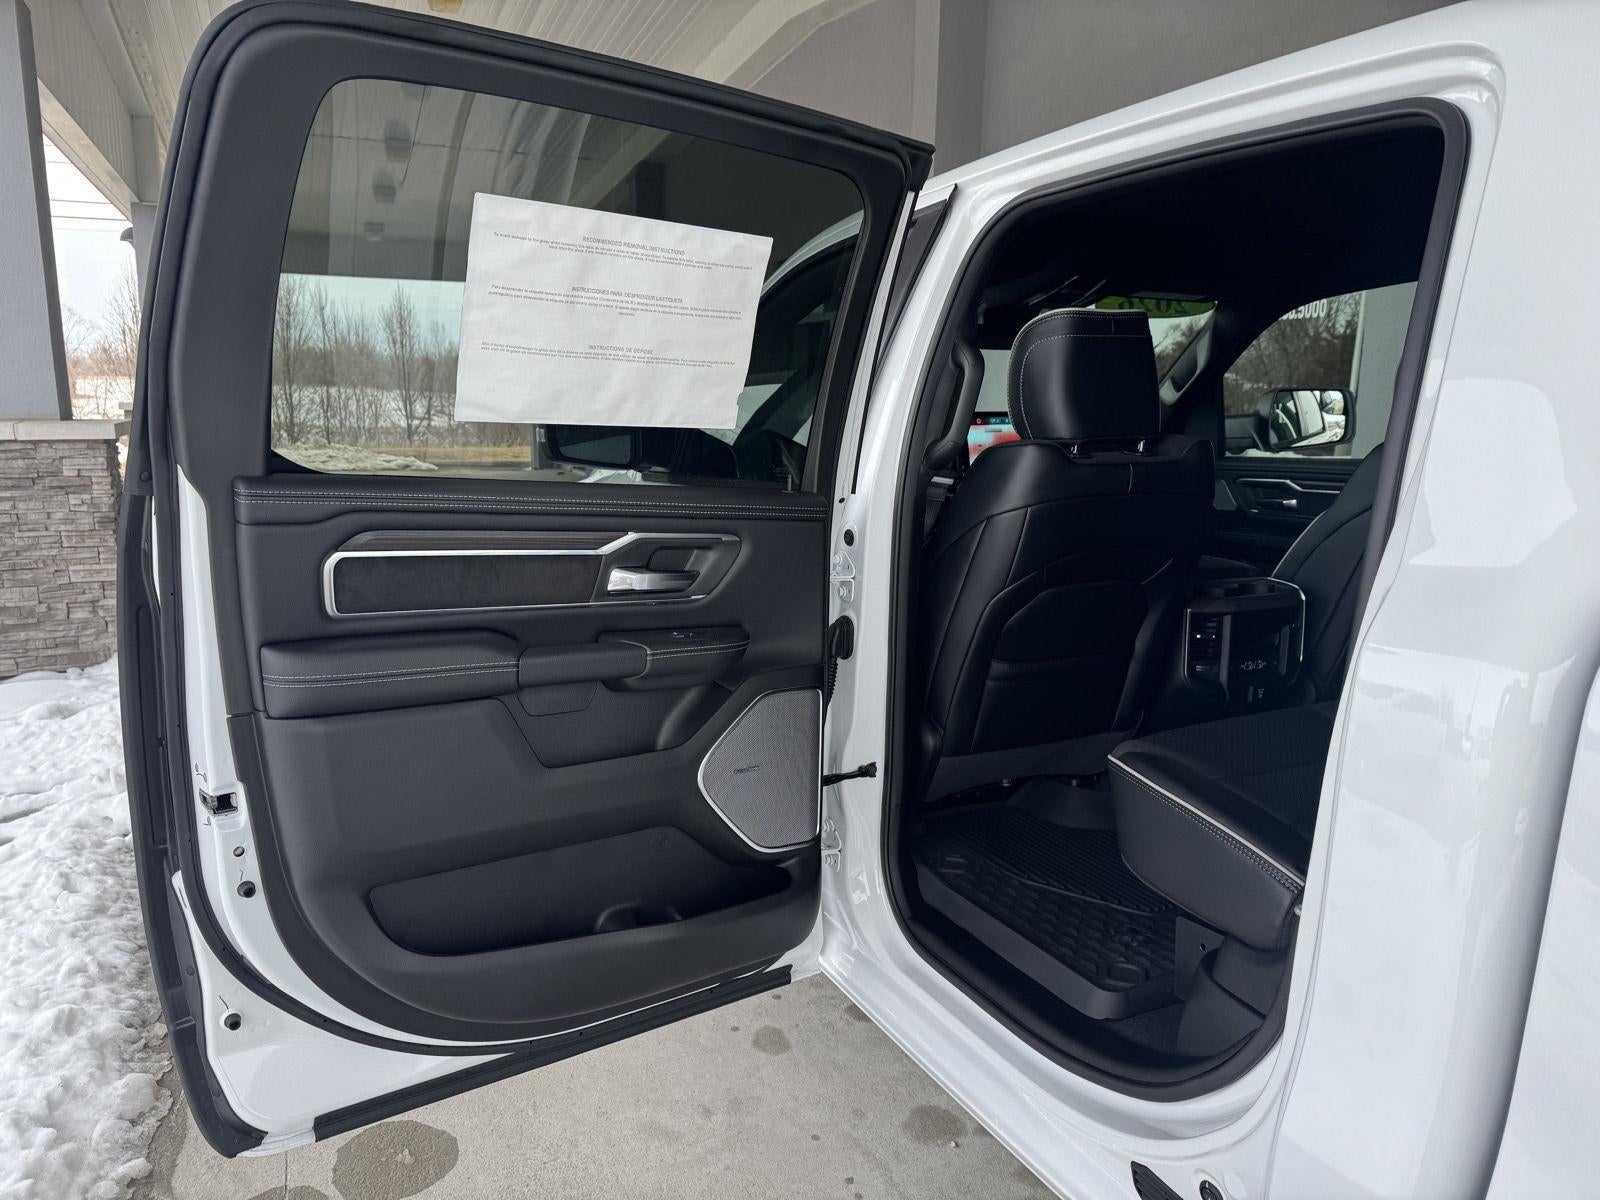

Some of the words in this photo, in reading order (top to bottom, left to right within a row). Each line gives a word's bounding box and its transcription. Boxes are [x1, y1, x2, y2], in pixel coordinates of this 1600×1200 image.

[582, 236, 622, 248] RECOMMENDED
[623, 241, 648, 251] REMOVAL
[649, 245, 686, 256] INSTRUCTIONS
